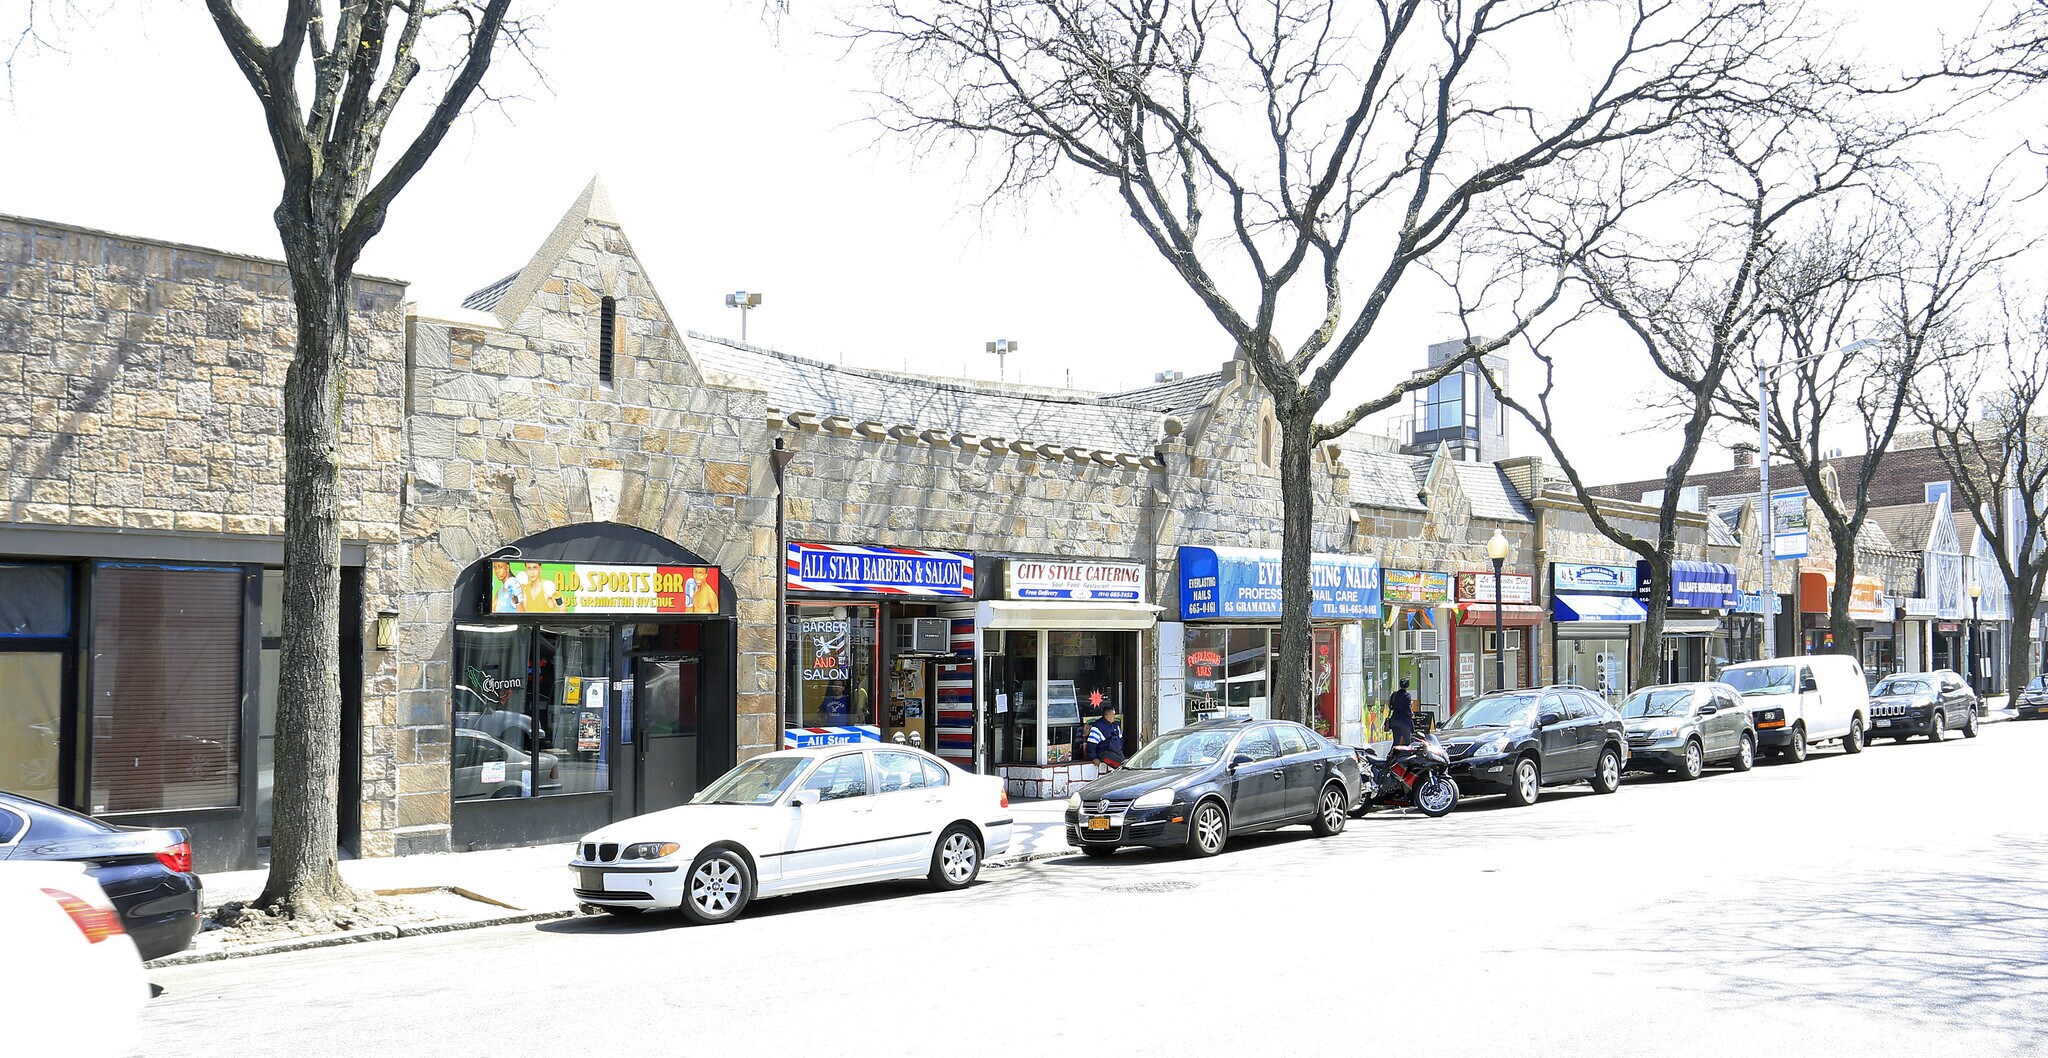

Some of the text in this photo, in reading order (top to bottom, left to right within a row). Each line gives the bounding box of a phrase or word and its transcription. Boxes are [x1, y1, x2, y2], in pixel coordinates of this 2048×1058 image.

[803, 554, 961, 585] ALL STAR BARBERS & SALON
[1017, 563, 1140, 582] CITY STYLE CATERING
[1258, 561, 1378, 589] EVETING NAILS
[554, 570, 684, 593] A.D. SPORTS BAR
[1188, 576, 1217, 589] EVERLASTING
[1193, 589, 1212, 601] NAILS
[1313, 589, 1333, 601] NAIL
[1335, 590, 1358, 602] CARE
[1736, 588, 1782, 615] Domi's
[580, 597, 636, 608] GRAMATAN
[636, 597, 675, 608] AVENUE
[1188, 601, 1216, 615] 665-0461
[1224, 601, 1234, 612] 85
[1236, 601, 1276, 612] GRAMATAN
[1322, 603, 1337, 614] TEL:
[802, 621, 848, 633] BARBER
[813, 656, 836, 669] AND
[803, 669, 849, 681] SALON
[482, 677, 522, 693] Corona
[1190, 697, 1218, 711] Nails
[806, 735, 850, 746] All Star
